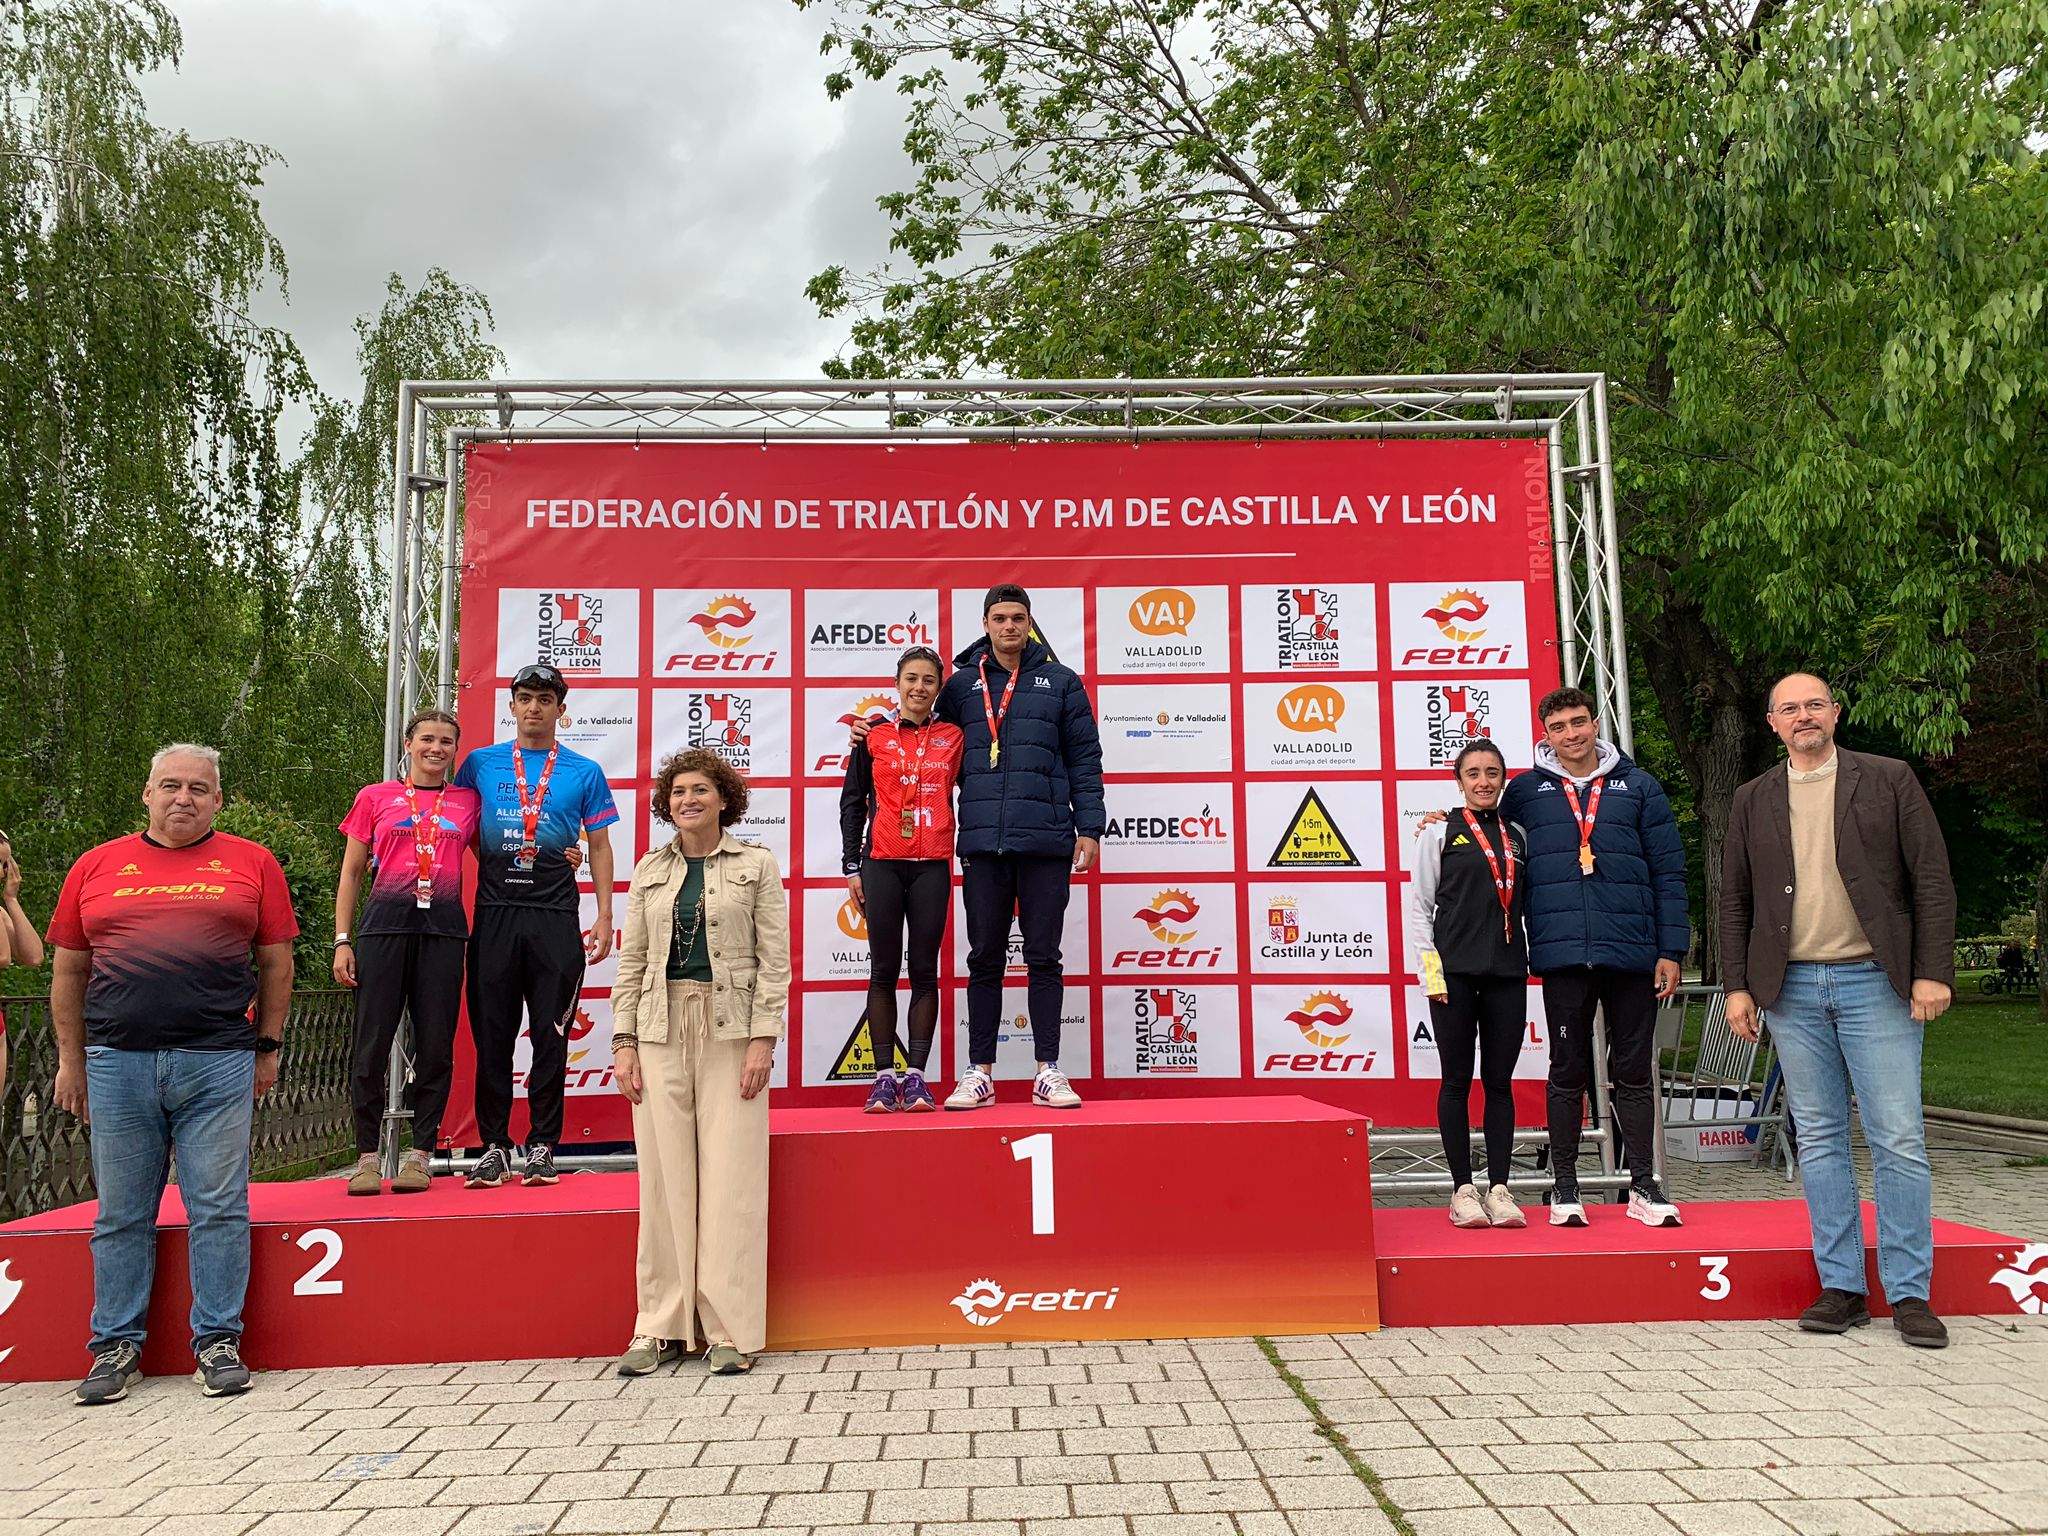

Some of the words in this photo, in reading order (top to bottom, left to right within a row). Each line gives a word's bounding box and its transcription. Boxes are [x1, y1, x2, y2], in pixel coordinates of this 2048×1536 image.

[527, 492, 762, 528] FEDERACIÓN
[774, 500, 820, 528] DE
[829, 492, 1009, 528] TRIATLÓN
[1020, 499, 1043, 528] Y
[1054, 498, 1114, 527] P.M
[1126, 497, 1172, 526] DE
[1180, 494, 1358, 527] CASTILLA
[1367, 495, 1391, 524] Y
[1402, 488, 1496, 523] LEÓN
[1135, 600, 1185, 627] VA!
[538, 593, 553, 667] RIATLON
[810, 624, 933, 645] AFEDECYL
[1277, 589, 1291, 669] TRIATLON
[553, 648, 601, 656] CASTILLA
[1125, 645, 1202, 657] VALLADOLID
[1292, 642, 1338, 650] CASTILLA
[569, 656, 601, 667] LEÓN
[1292, 653, 1300, 661] Y
[1308, 650, 1338, 661] LEÓN
[1146, 661, 1166, 669] amiga
[1179, 660, 1205, 669] deporte
[1034, 676, 1050, 686] UA
[1283, 697, 1335, 723] VA!
[577, 715, 588, 725] de
[590, 715, 632, 725] Valladolid
[1103, 714, 1152, 723] Ayuntamiento
[1174, 714, 1184, 722] de
[1186, 714, 1226, 722] Valladolid
[1427, 686, 1443, 767] TRIATLON
[1273, 743, 1353, 754] VALLADOLID
[1295, 758, 1315, 766] amiga
[1329, 757, 1355, 766] deporte
[1609, 779, 1626, 789] UA
[744, 816, 785, 825] Valladolid
[1104, 817, 1227, 838] AFEDECYL
[1287, 851, 1299, 859] YO
[1302, 851, 1341, 859] RESPETO
[1304, 931, 1347, 943] Junta
[1353, 931, 1372, 943] de
[1261, 945, 1315, 958] Castilla
[1320, 948, 1330, 961] y
[1335, 945, 1372, 958] León
[853, 967, 871, 976] amig
[1135, 989, 1149, 1073] TRIATLON
[1150, 1045, 1197, 1053] CASTILLA
[1150, 1056, 1157, 1065] Y
[1166, 1053, 1197, 1065] LEÓN
[847, 1063, 859, 1071] YO
[1699, 1129, 1755, 1146] HARIB
[1011, 1133, 1055, 1234] 1
[293, 1228, 343, 1296] 2
[1699, 1256, 1731, 1300] 3
